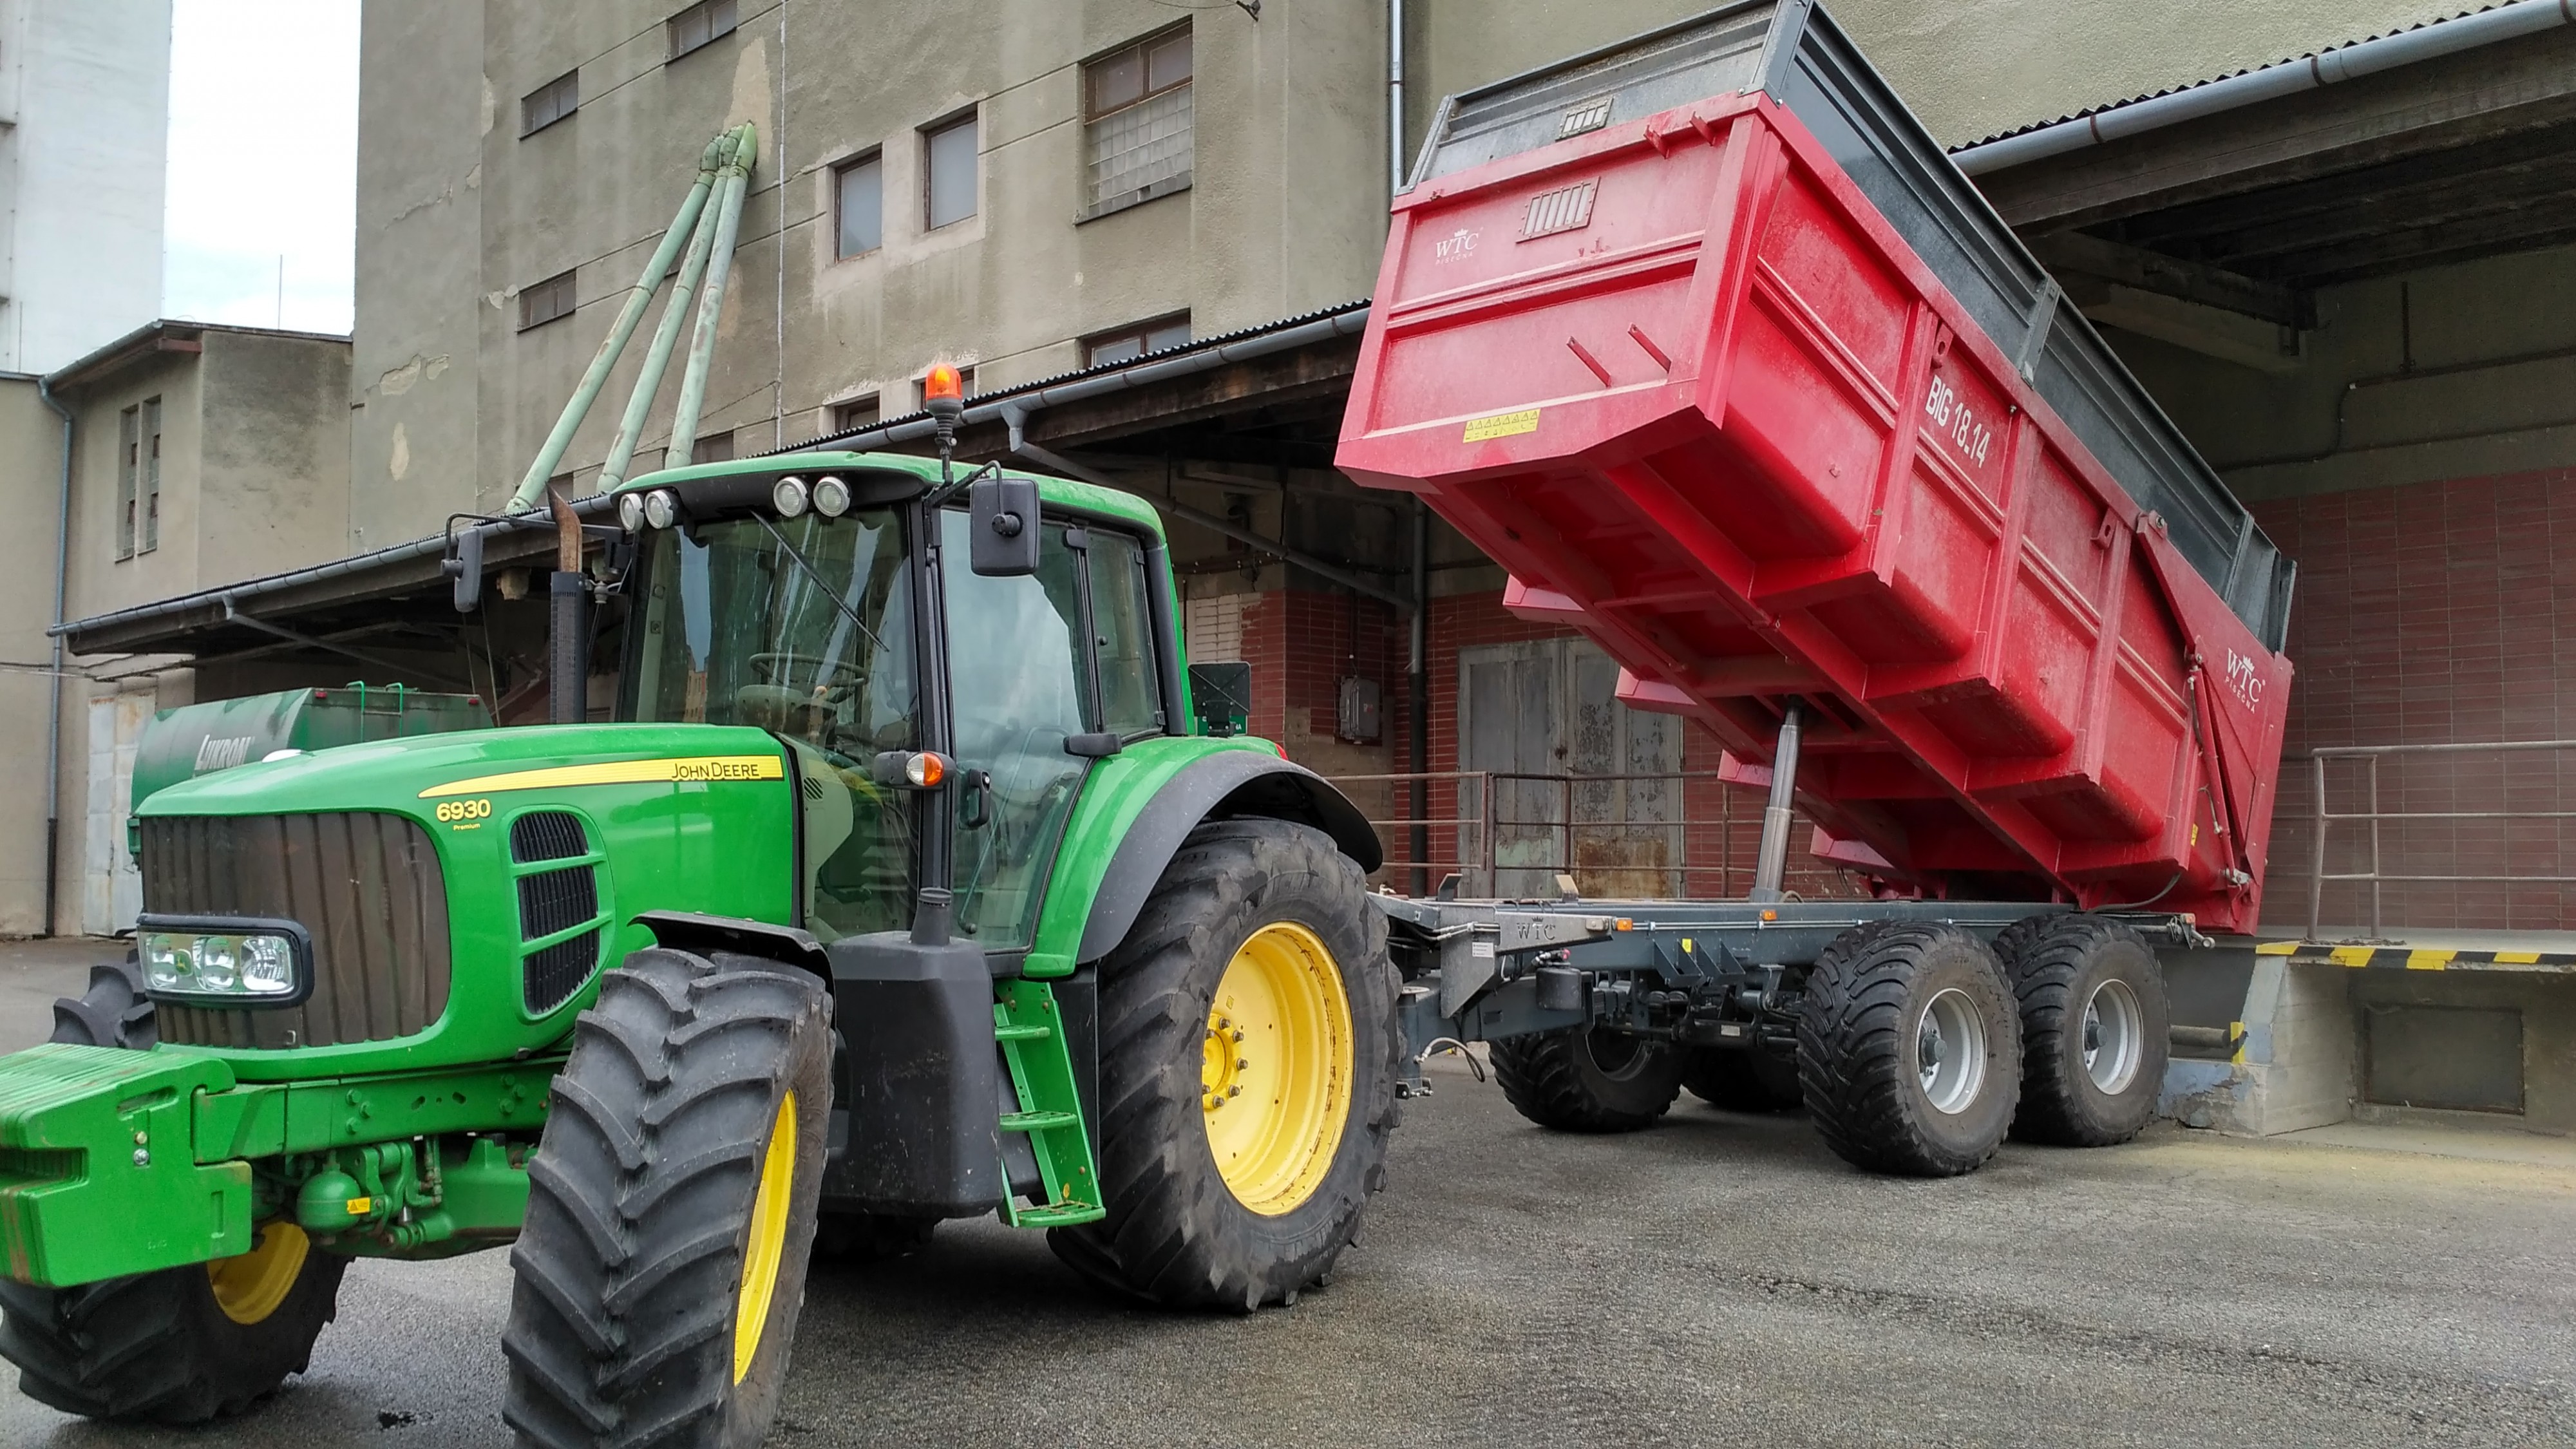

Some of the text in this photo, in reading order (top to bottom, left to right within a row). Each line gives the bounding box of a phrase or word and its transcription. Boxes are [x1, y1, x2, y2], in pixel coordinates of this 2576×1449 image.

[1436, 232, 1479, 258] WTC
[1926, 374, 1991, 469] BIG 18.14
[2228, 647, 2262, 703] WTC
[672, 762, 759, 779] JOHN DEERE
[437, 799, 491, 821] 6930
[1516, 922, 1556, 940] WTC
